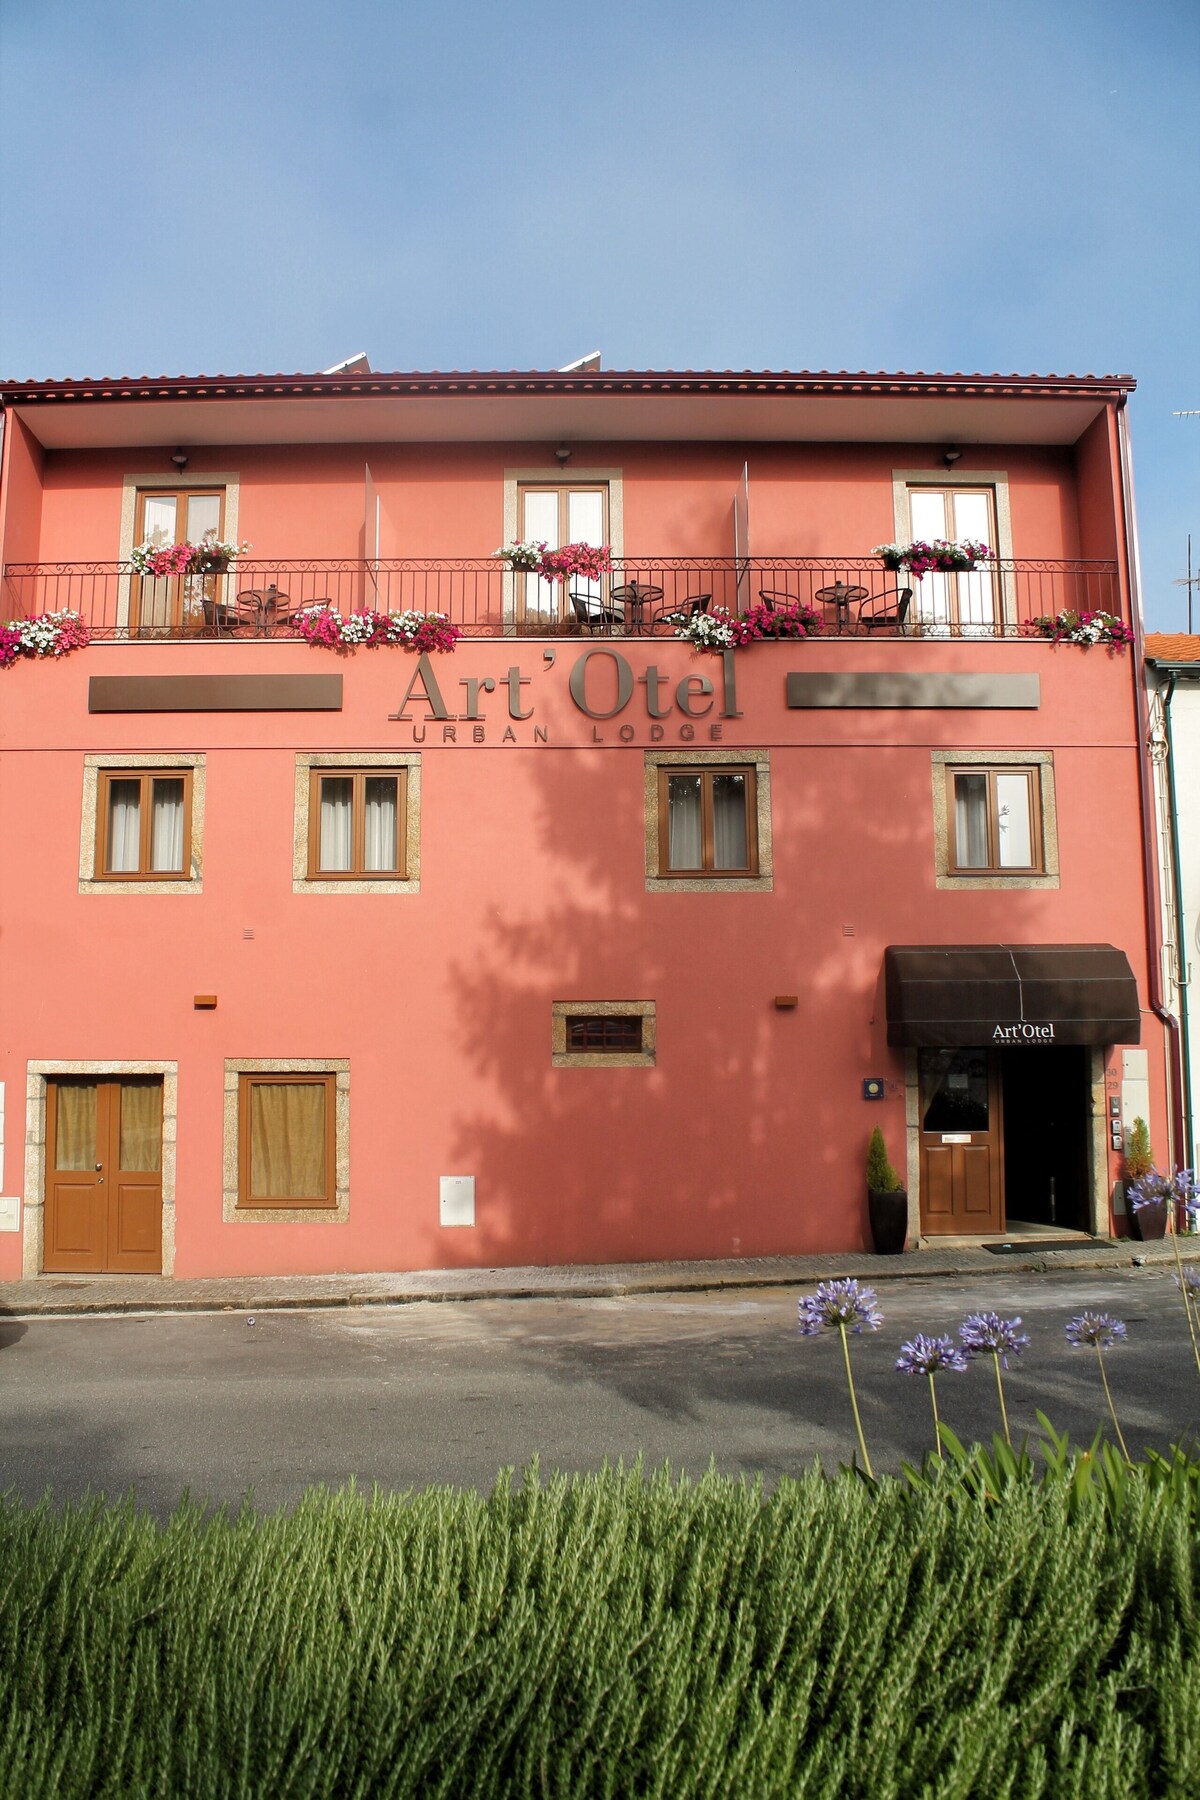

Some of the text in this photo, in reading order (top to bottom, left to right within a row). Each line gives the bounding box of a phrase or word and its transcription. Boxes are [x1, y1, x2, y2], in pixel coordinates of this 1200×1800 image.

[388, 646, 743, 721] Art'Otel
[412, 723, 723, 743] URBAN LODGE
[992, 1023, 1055, 1039] Art'Otel
[1106, 1081, 1119, 1090] 29
